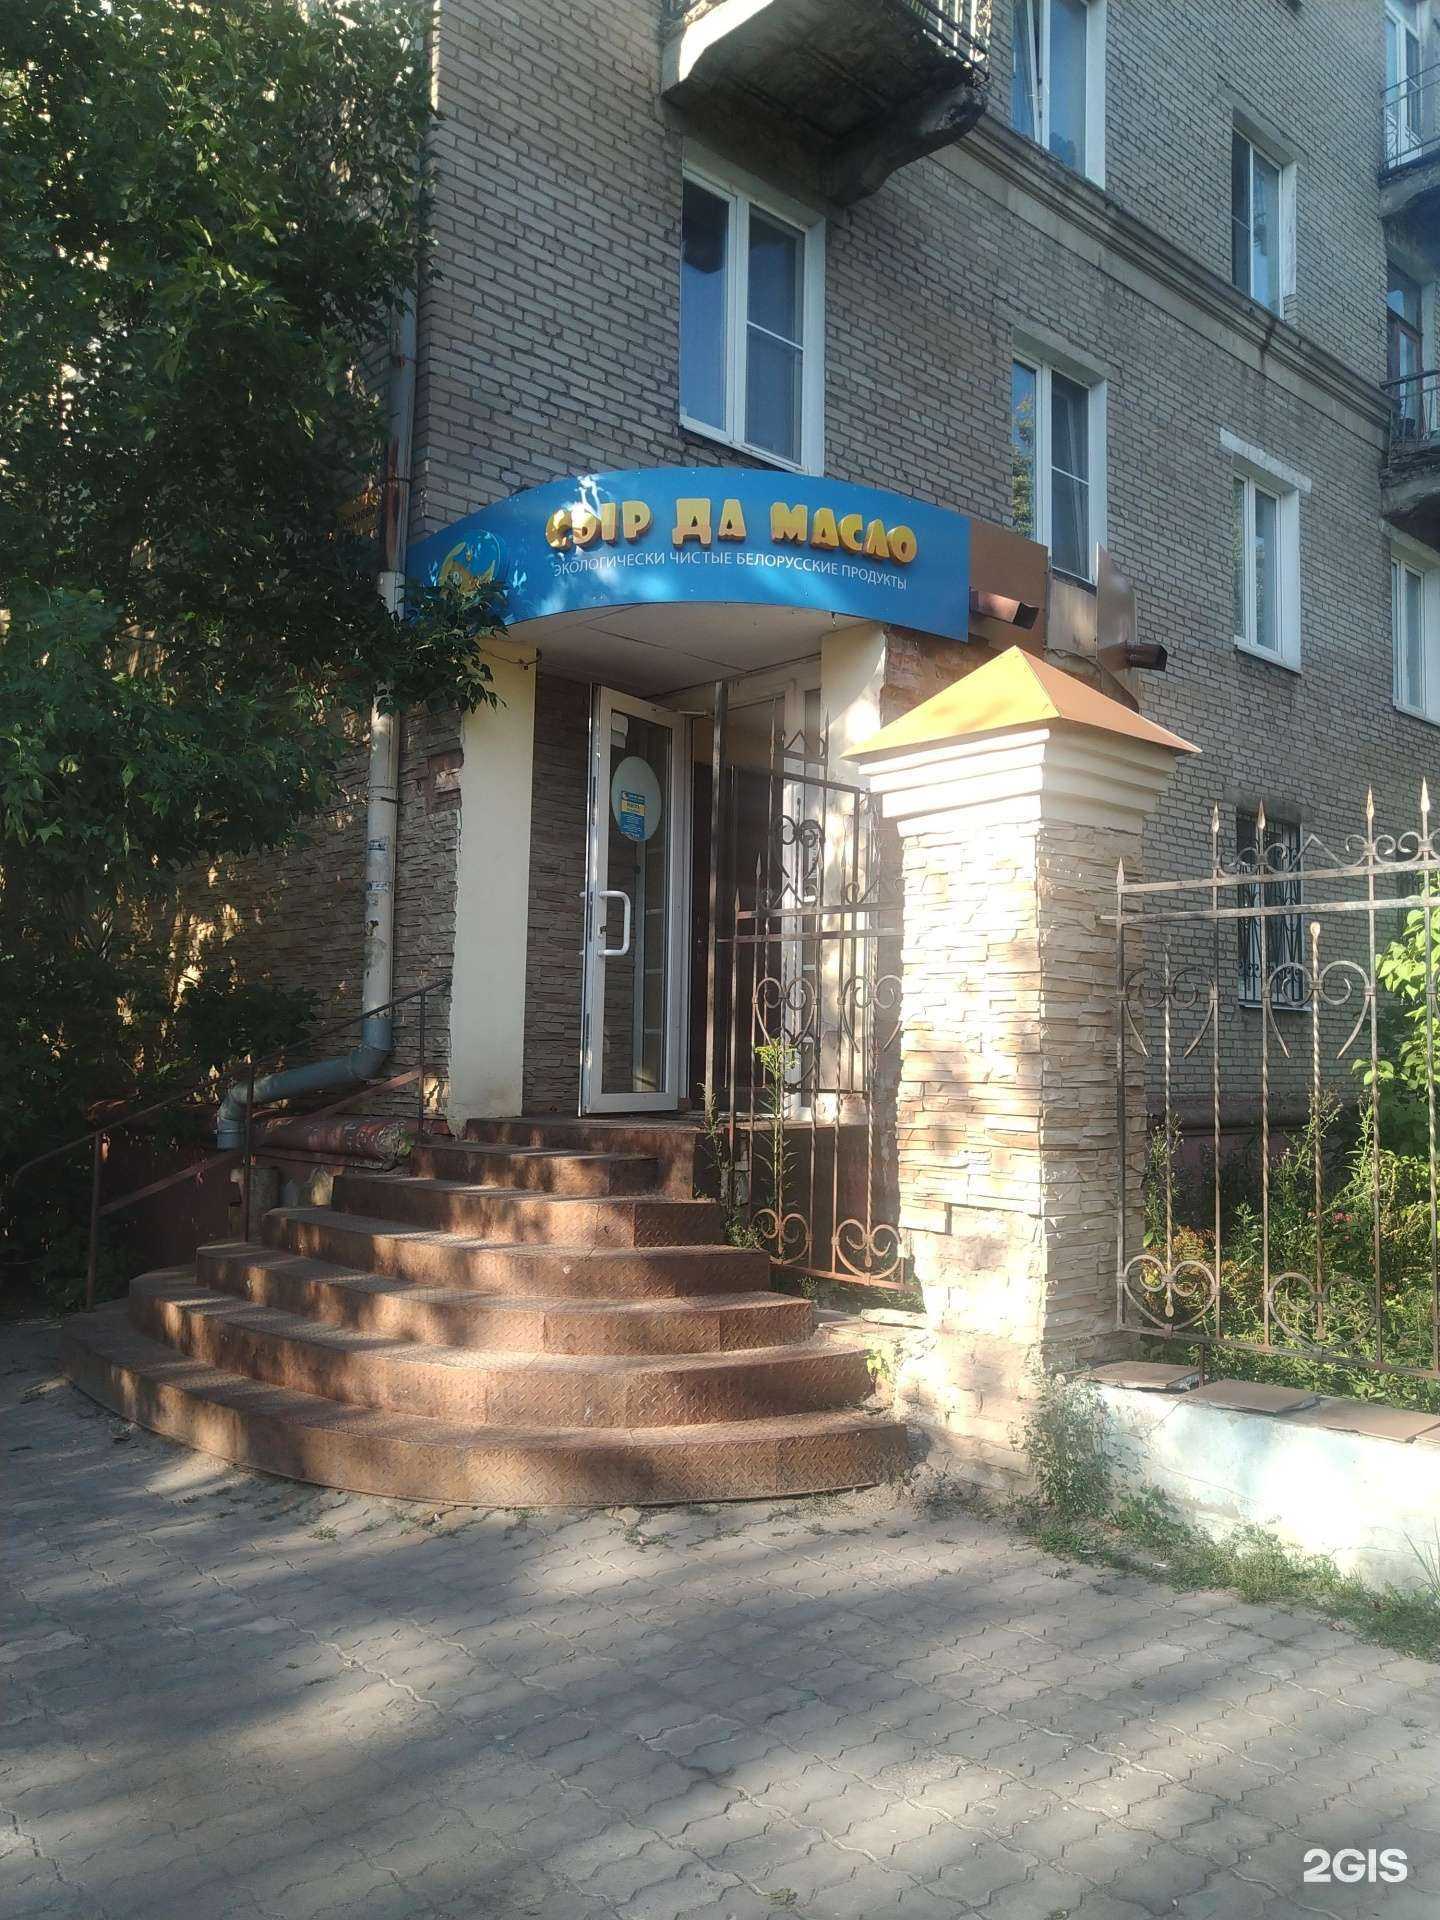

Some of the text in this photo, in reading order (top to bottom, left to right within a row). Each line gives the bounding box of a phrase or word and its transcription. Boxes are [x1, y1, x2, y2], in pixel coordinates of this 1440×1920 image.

[546, 498, 917, 565] СЫР ДА МАСЛО
[554, 551, 907, 590] ЭКОЛОГИЧЕСКИ ЧИСТЫЕ БЕЛОРУССКИЕ ПРОДУКТЫ
